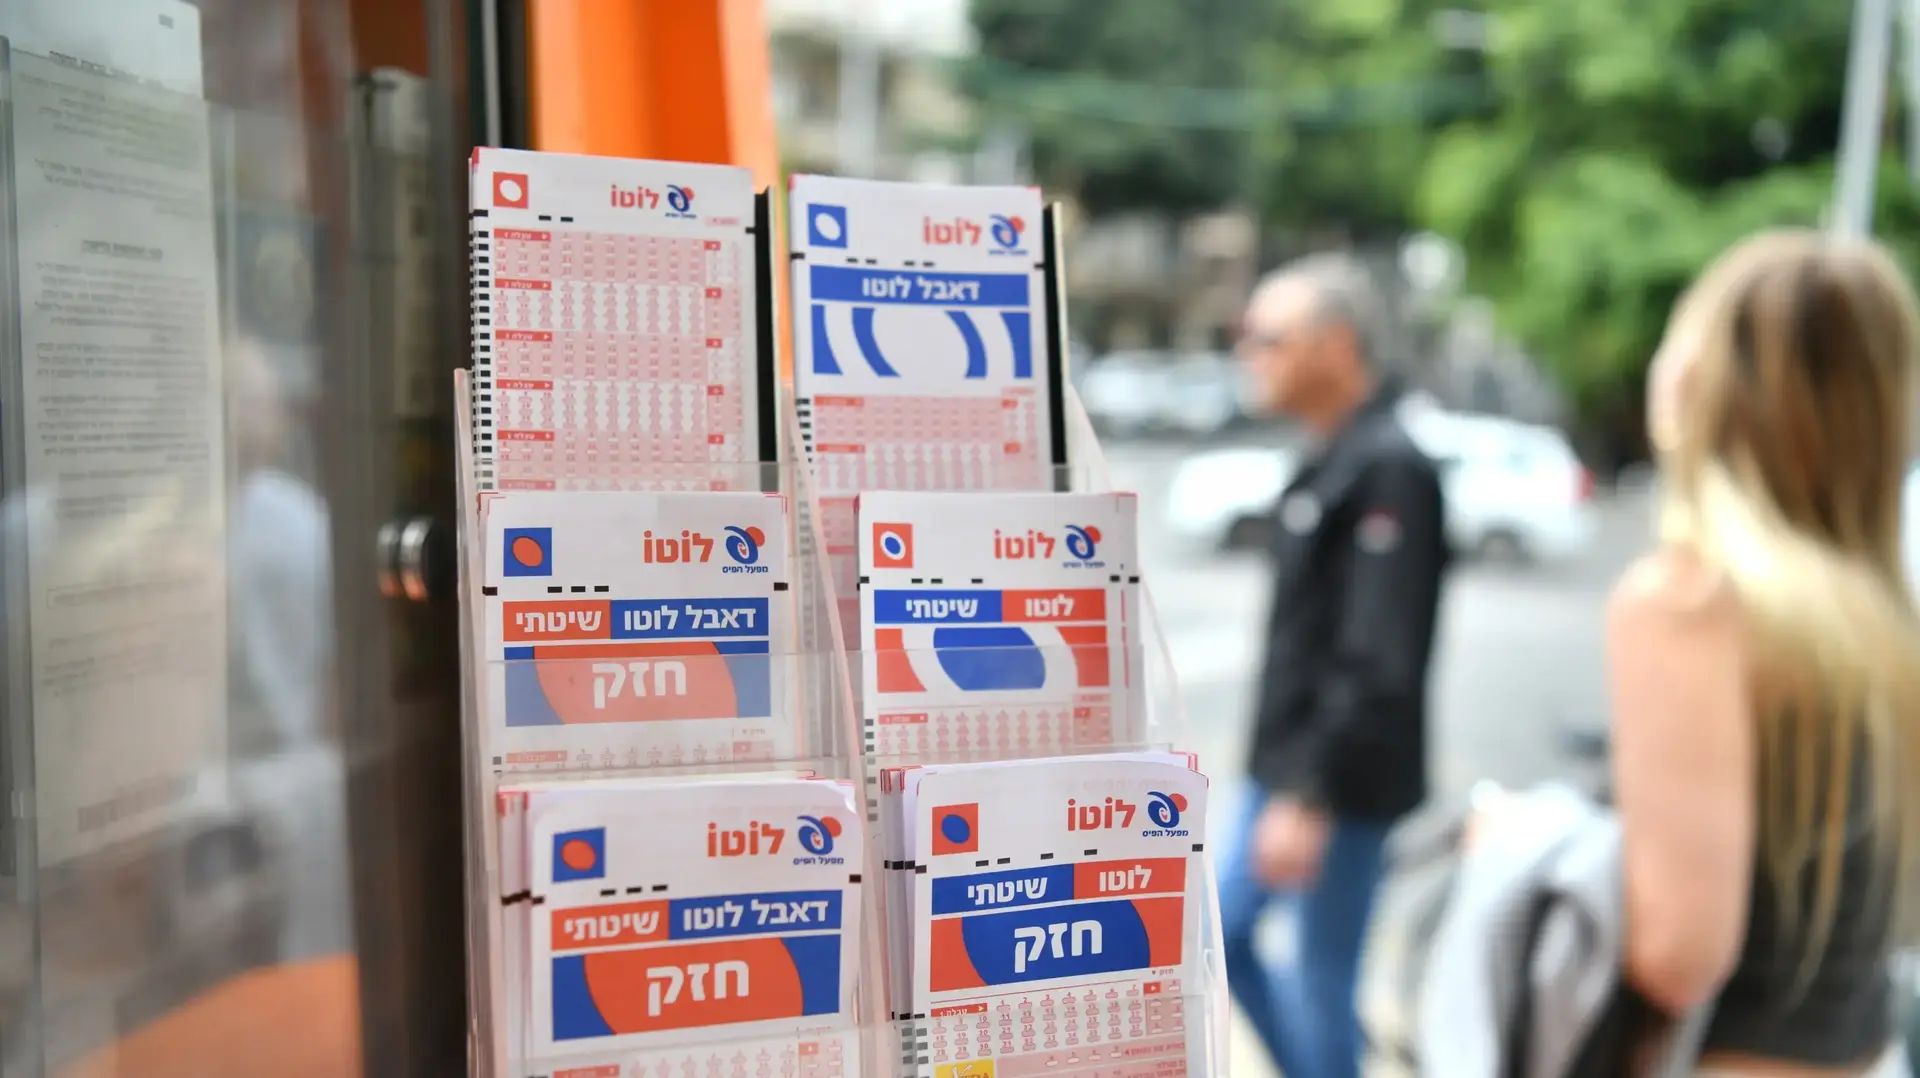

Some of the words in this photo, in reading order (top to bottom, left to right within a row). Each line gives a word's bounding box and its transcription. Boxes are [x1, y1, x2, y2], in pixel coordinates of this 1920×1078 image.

[862, 276, 912, 297] לוטו
[917, 277, 980, 301] דאבל
[722, 565, 743, 574] הפיס
[744, 564, 769, 573] מפעל
[686, 604, 757, 629] דאבל
[905, 598, 979, 618] שיטתי
[1025, 594, 1074, 617] לוטו
[516, 610, 602, 633] שיטתי
[624, 605, 679, 631] לוטו
[592, 660, 687, 709] חזק
[1142, 829, 1163, 838] הפיס
[1164, 829, 1189, 837] מפעל
[817, 856, 844, 865] מפעל
[1099, 865, 1152, 892] לוטו
[967, 877, 1048, 906] שיטתי
[683, 899, 744, 932] לוטו
[752, 898, 830, 926] דאבל
[564, 911, 660, 941] שיטתי
[1014, 920, 1103, 974] חזק
[646, 960, 749, 1017] חזק
